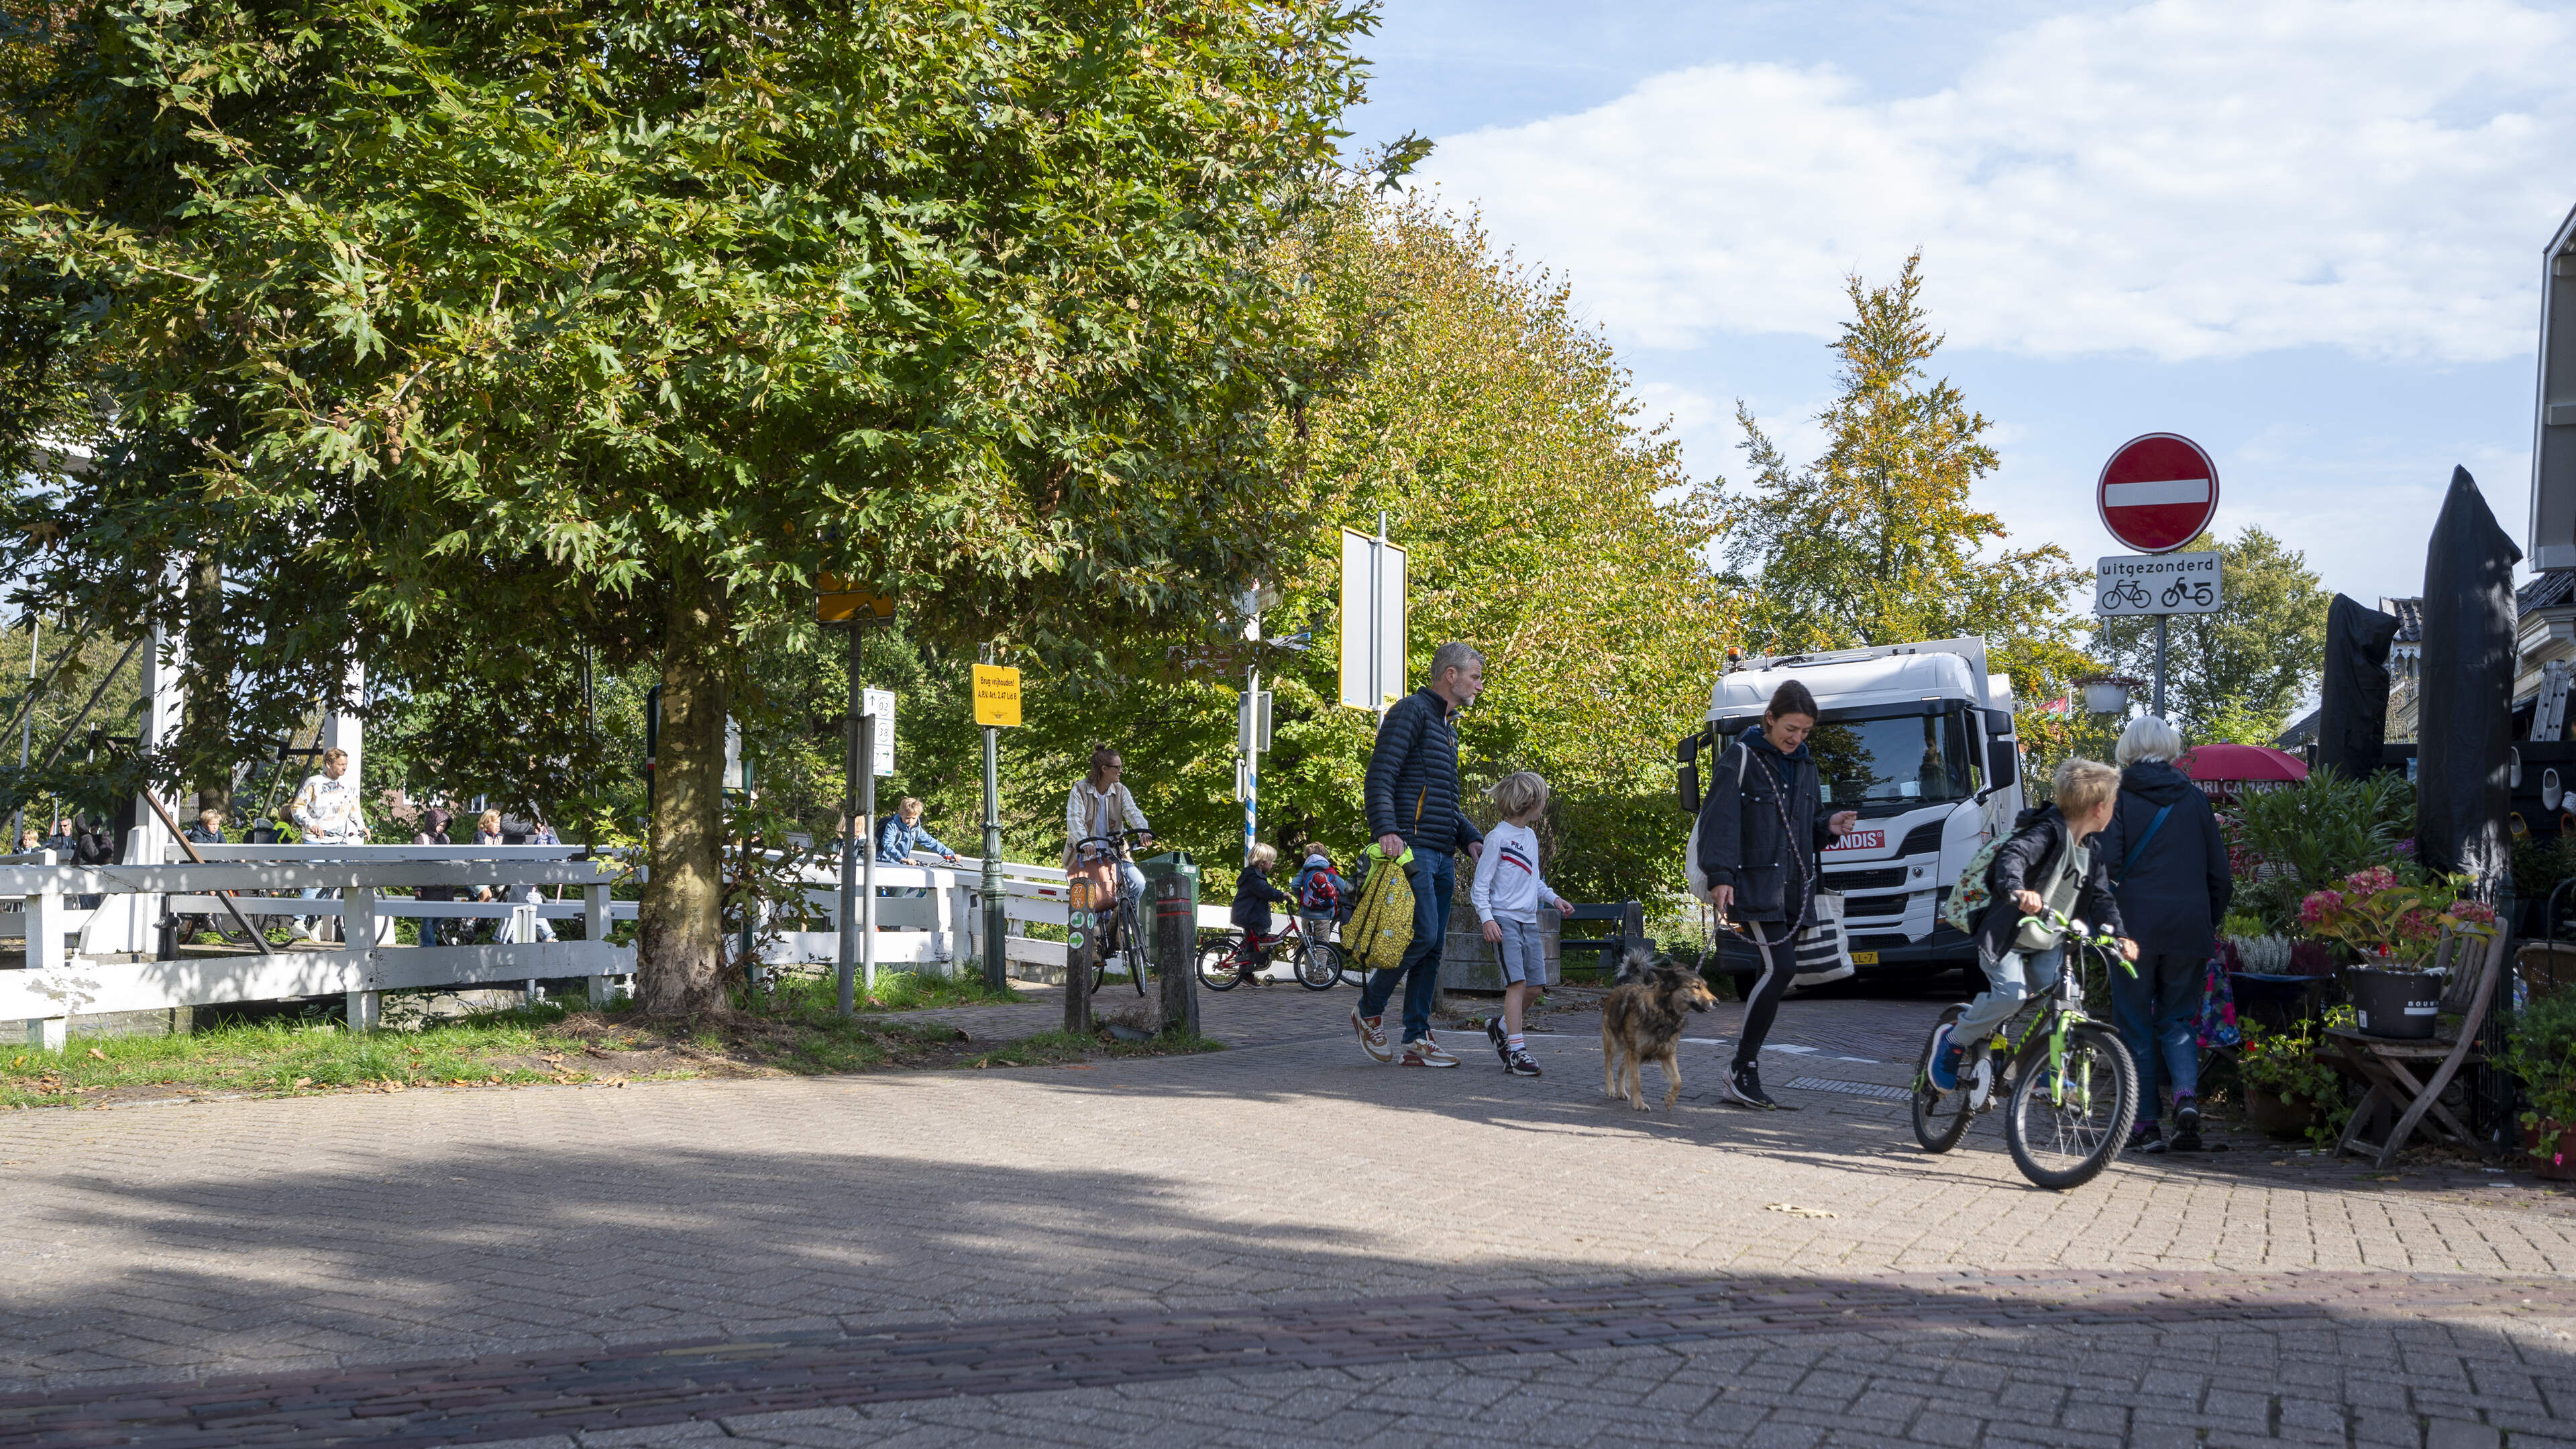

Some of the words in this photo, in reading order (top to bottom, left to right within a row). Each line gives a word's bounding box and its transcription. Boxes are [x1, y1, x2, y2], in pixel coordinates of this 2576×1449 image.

[2102, 558, 2214, 578] uitgezonderd
[980, 676, 991, 687] Brug
[991, 678, 1015, 688] vrijhouden!
[879, 702, 889, 711] 02
[879, 728, 889, 737] 38
[1511, 841, 1524, 851] FILA
[1073, 885, 1083, 894] 27
[1851, 953, 1874, 963] LL-7
